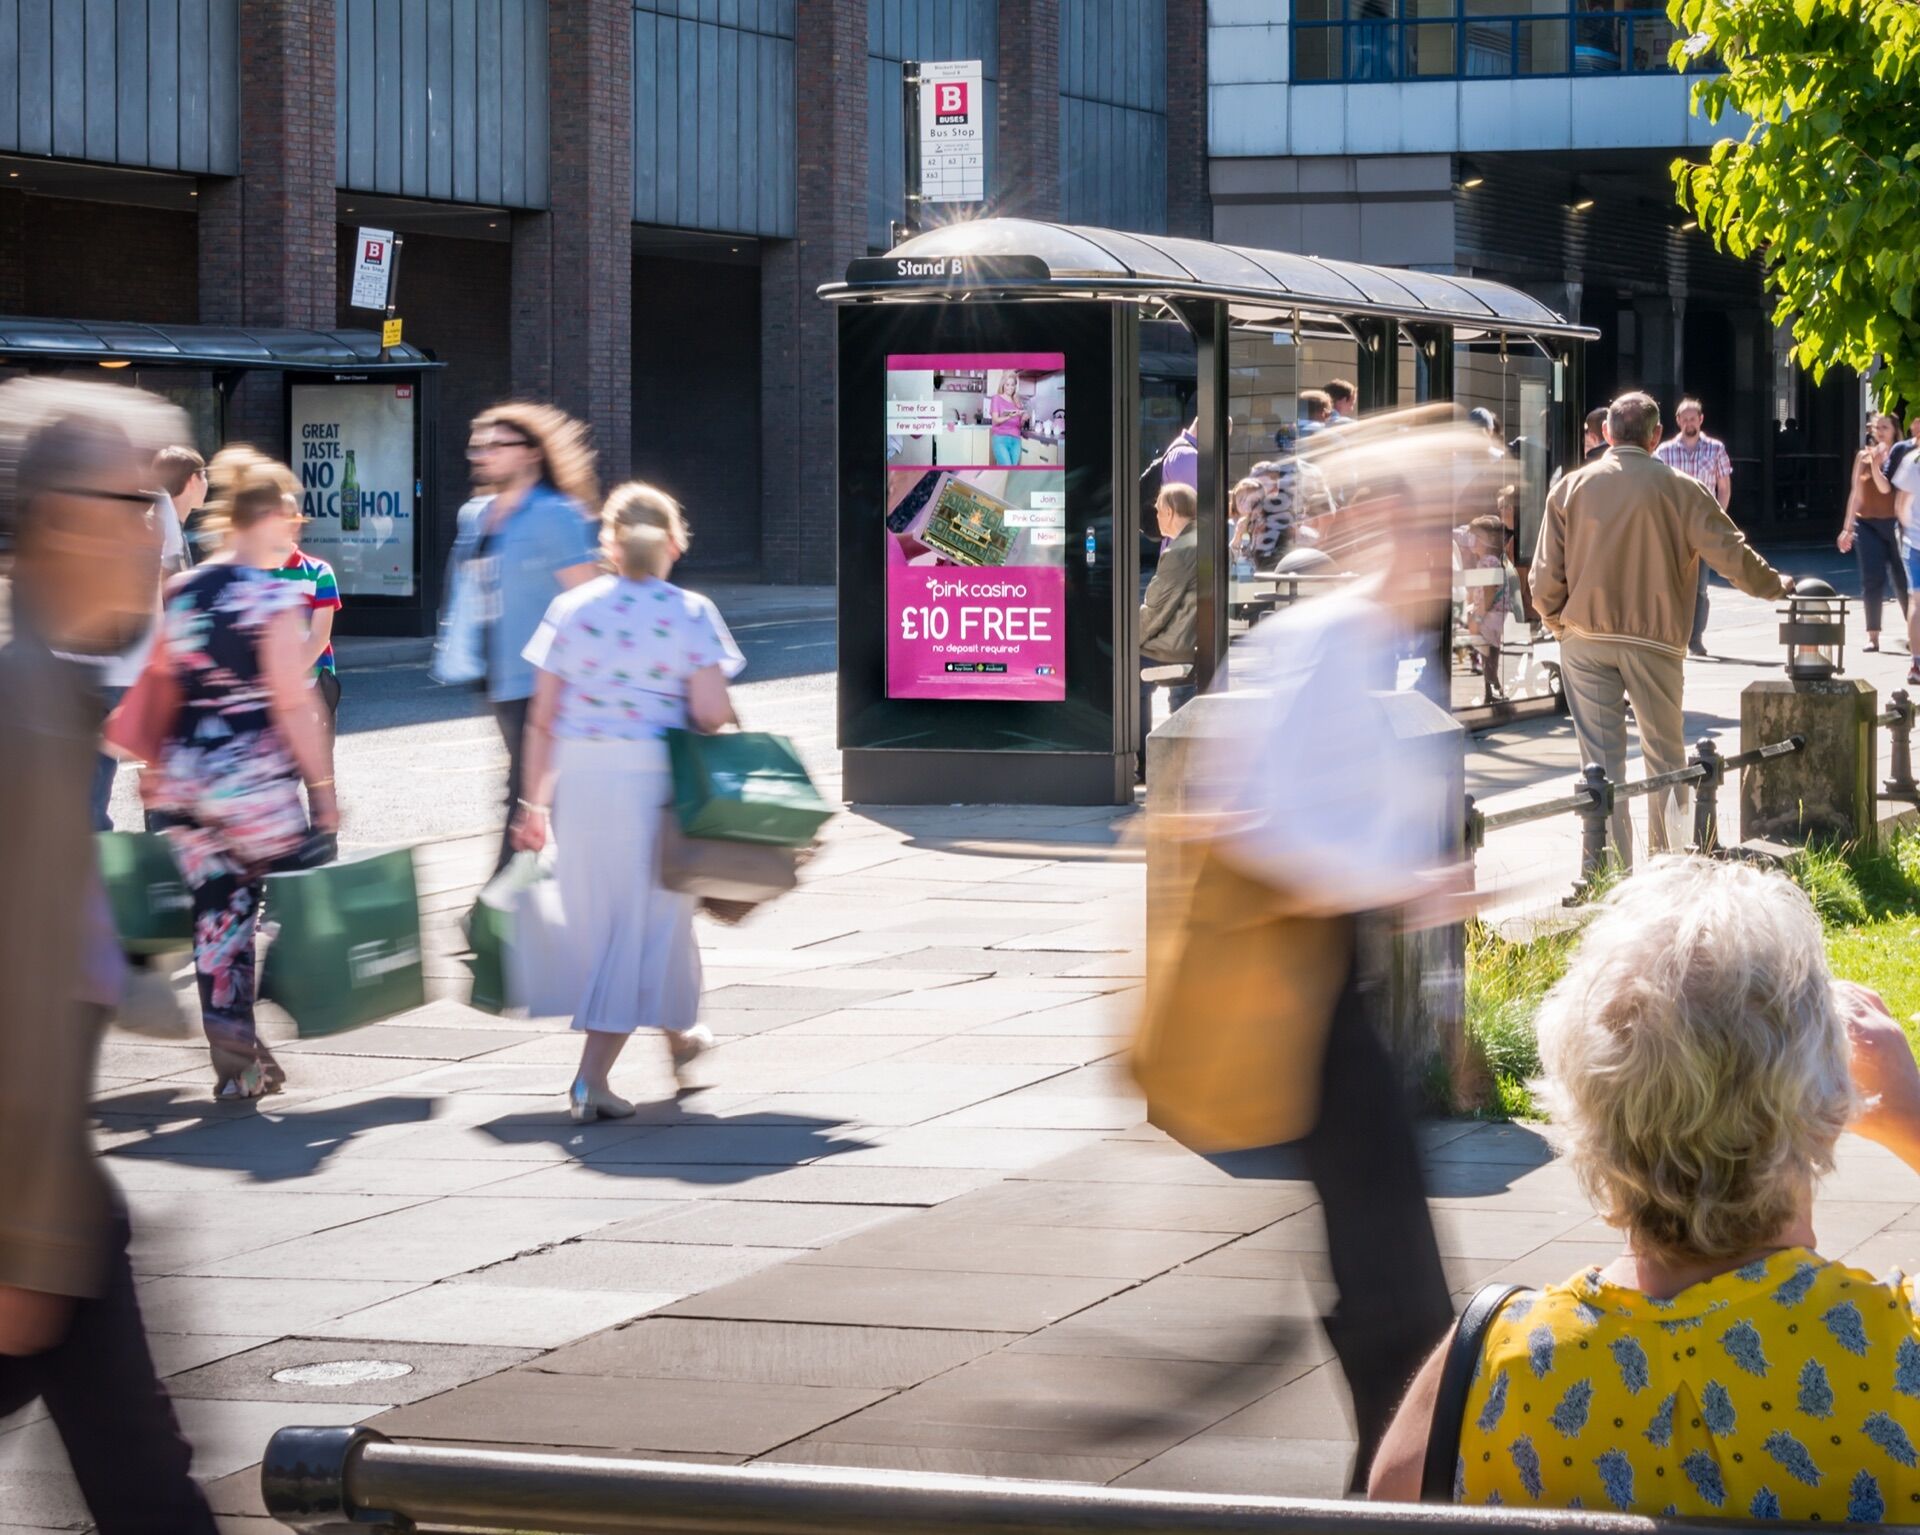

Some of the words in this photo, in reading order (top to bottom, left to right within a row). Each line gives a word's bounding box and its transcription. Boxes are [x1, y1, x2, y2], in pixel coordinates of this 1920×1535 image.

[941, 86, 962, 112] B
[930, 129, 948, 137] Bus
[952, 128, 975, 138] Stop
[368, 243, 380, 257] B
[897, 259, 945, 276] Stand
[951, 259, 963, 274] B
[397, 389, 410, 397] NEW
[917, 404, 927, 412] for
[302, 423, 340, 439] GREAT
[896, 422, 910, 430] few
[912, 422, 936, 431] spins?
[302, 442, 344, 459] TASTE.
[302, 461, 334, 489] NO
[932, 580, 969, 602] pink
[970, 581, 1027, 598] casino
[901, 606, 949, 640] £10
[960, 606, 1052, 641] FREE
[932, 645, 944, 653] no
[946, 644, 979, 654] deposit
[981, 645, 1020, 655] required
